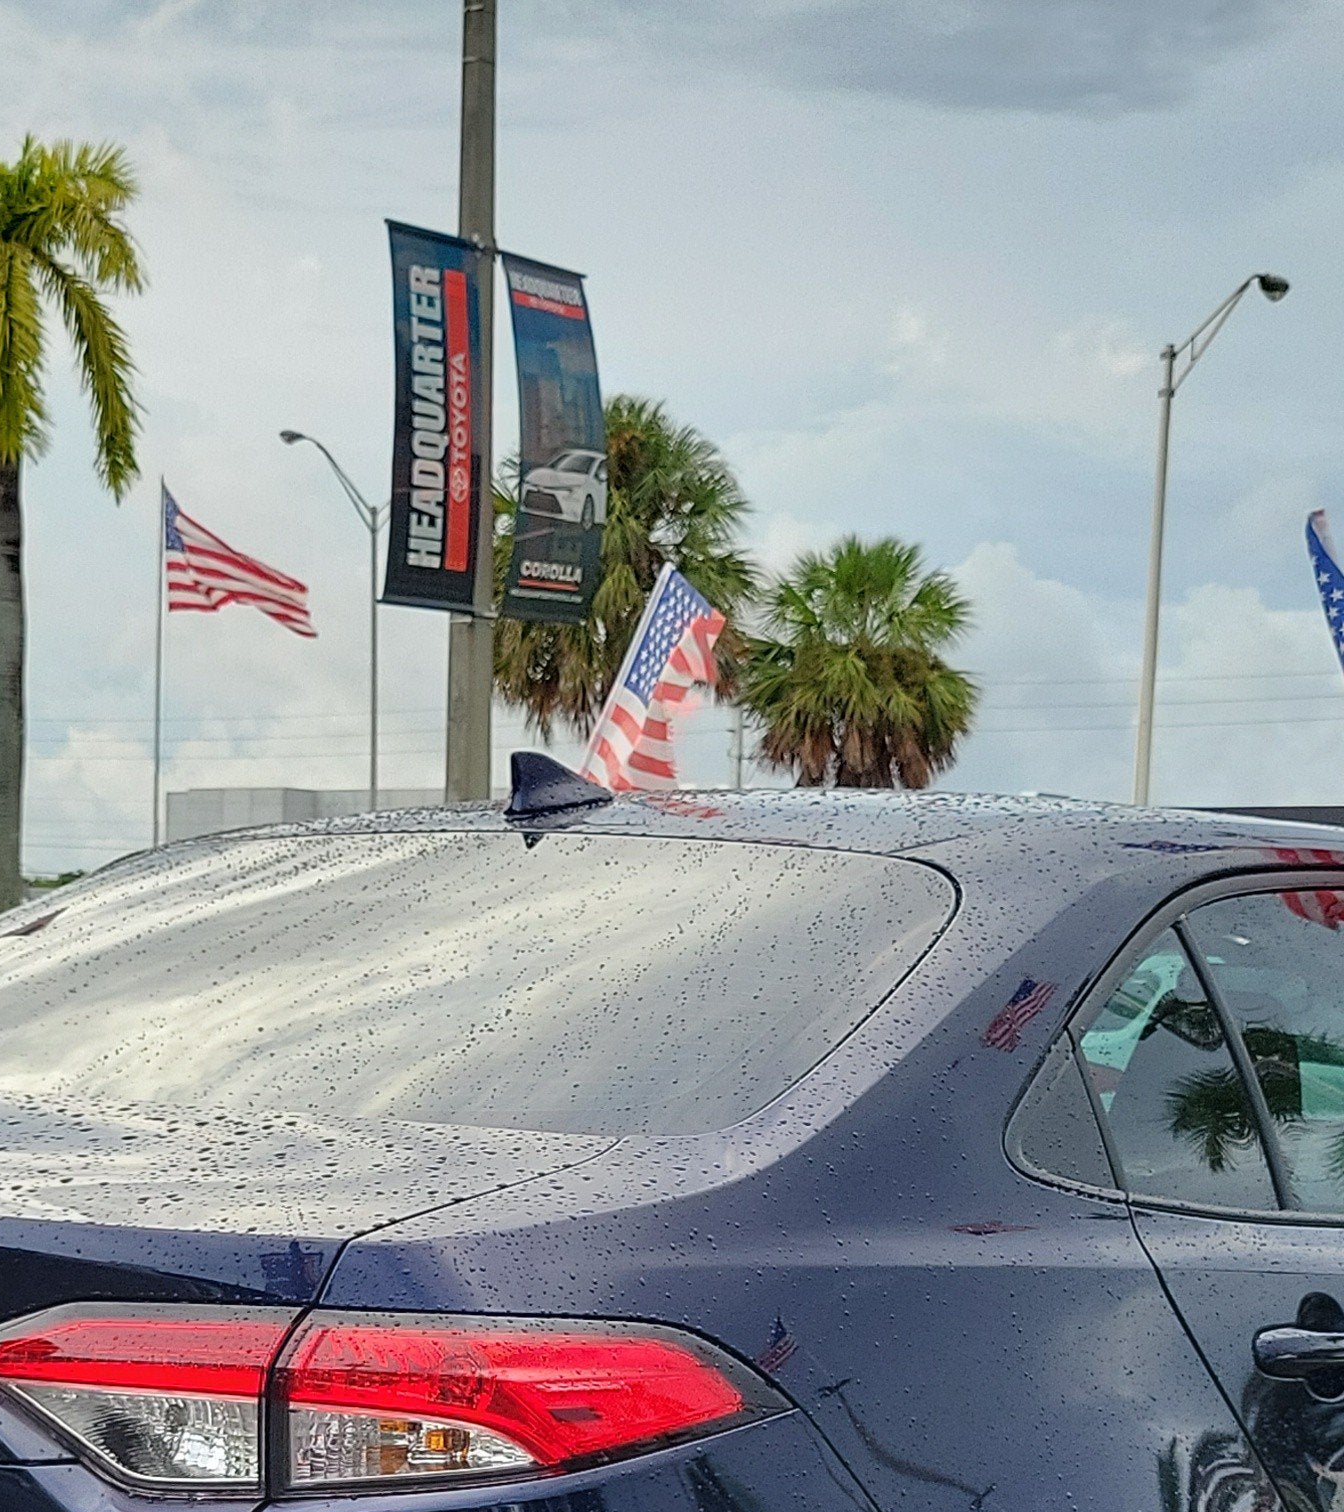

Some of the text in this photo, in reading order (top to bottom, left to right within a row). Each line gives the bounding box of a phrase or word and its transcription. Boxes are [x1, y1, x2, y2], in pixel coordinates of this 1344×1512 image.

[406, 264, 450, 570] HEADQUARTER
[449, 352, 467, 461] TOYOTA
[520, 560, 583, 584] COROLLA
